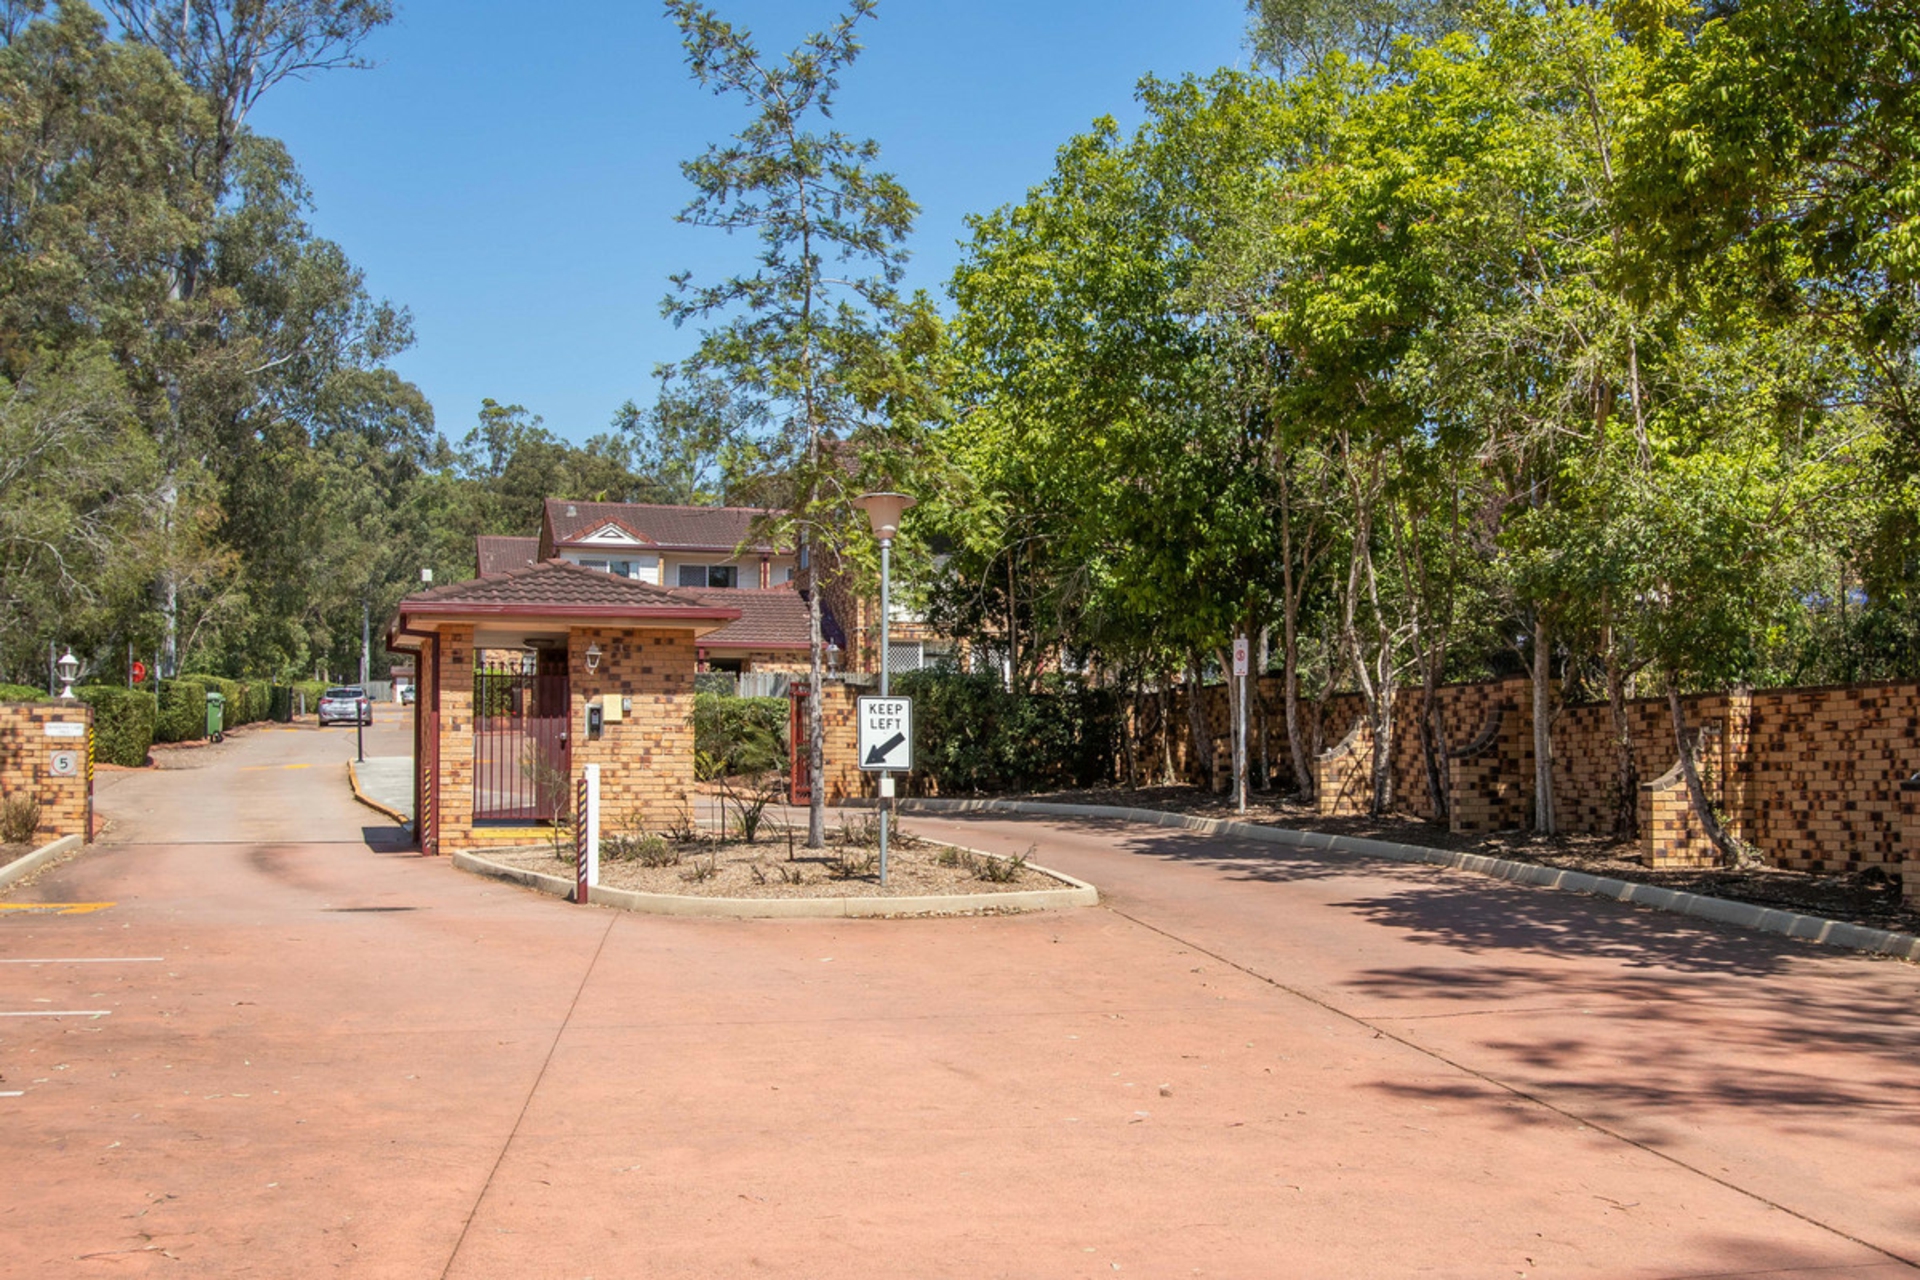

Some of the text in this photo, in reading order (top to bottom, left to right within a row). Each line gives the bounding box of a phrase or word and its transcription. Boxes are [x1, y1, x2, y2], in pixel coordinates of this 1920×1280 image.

[869, 703, 903, 715] KEEP
[870, 718, 901, 730] LEFT
[60, 757, 68, 769] 5
